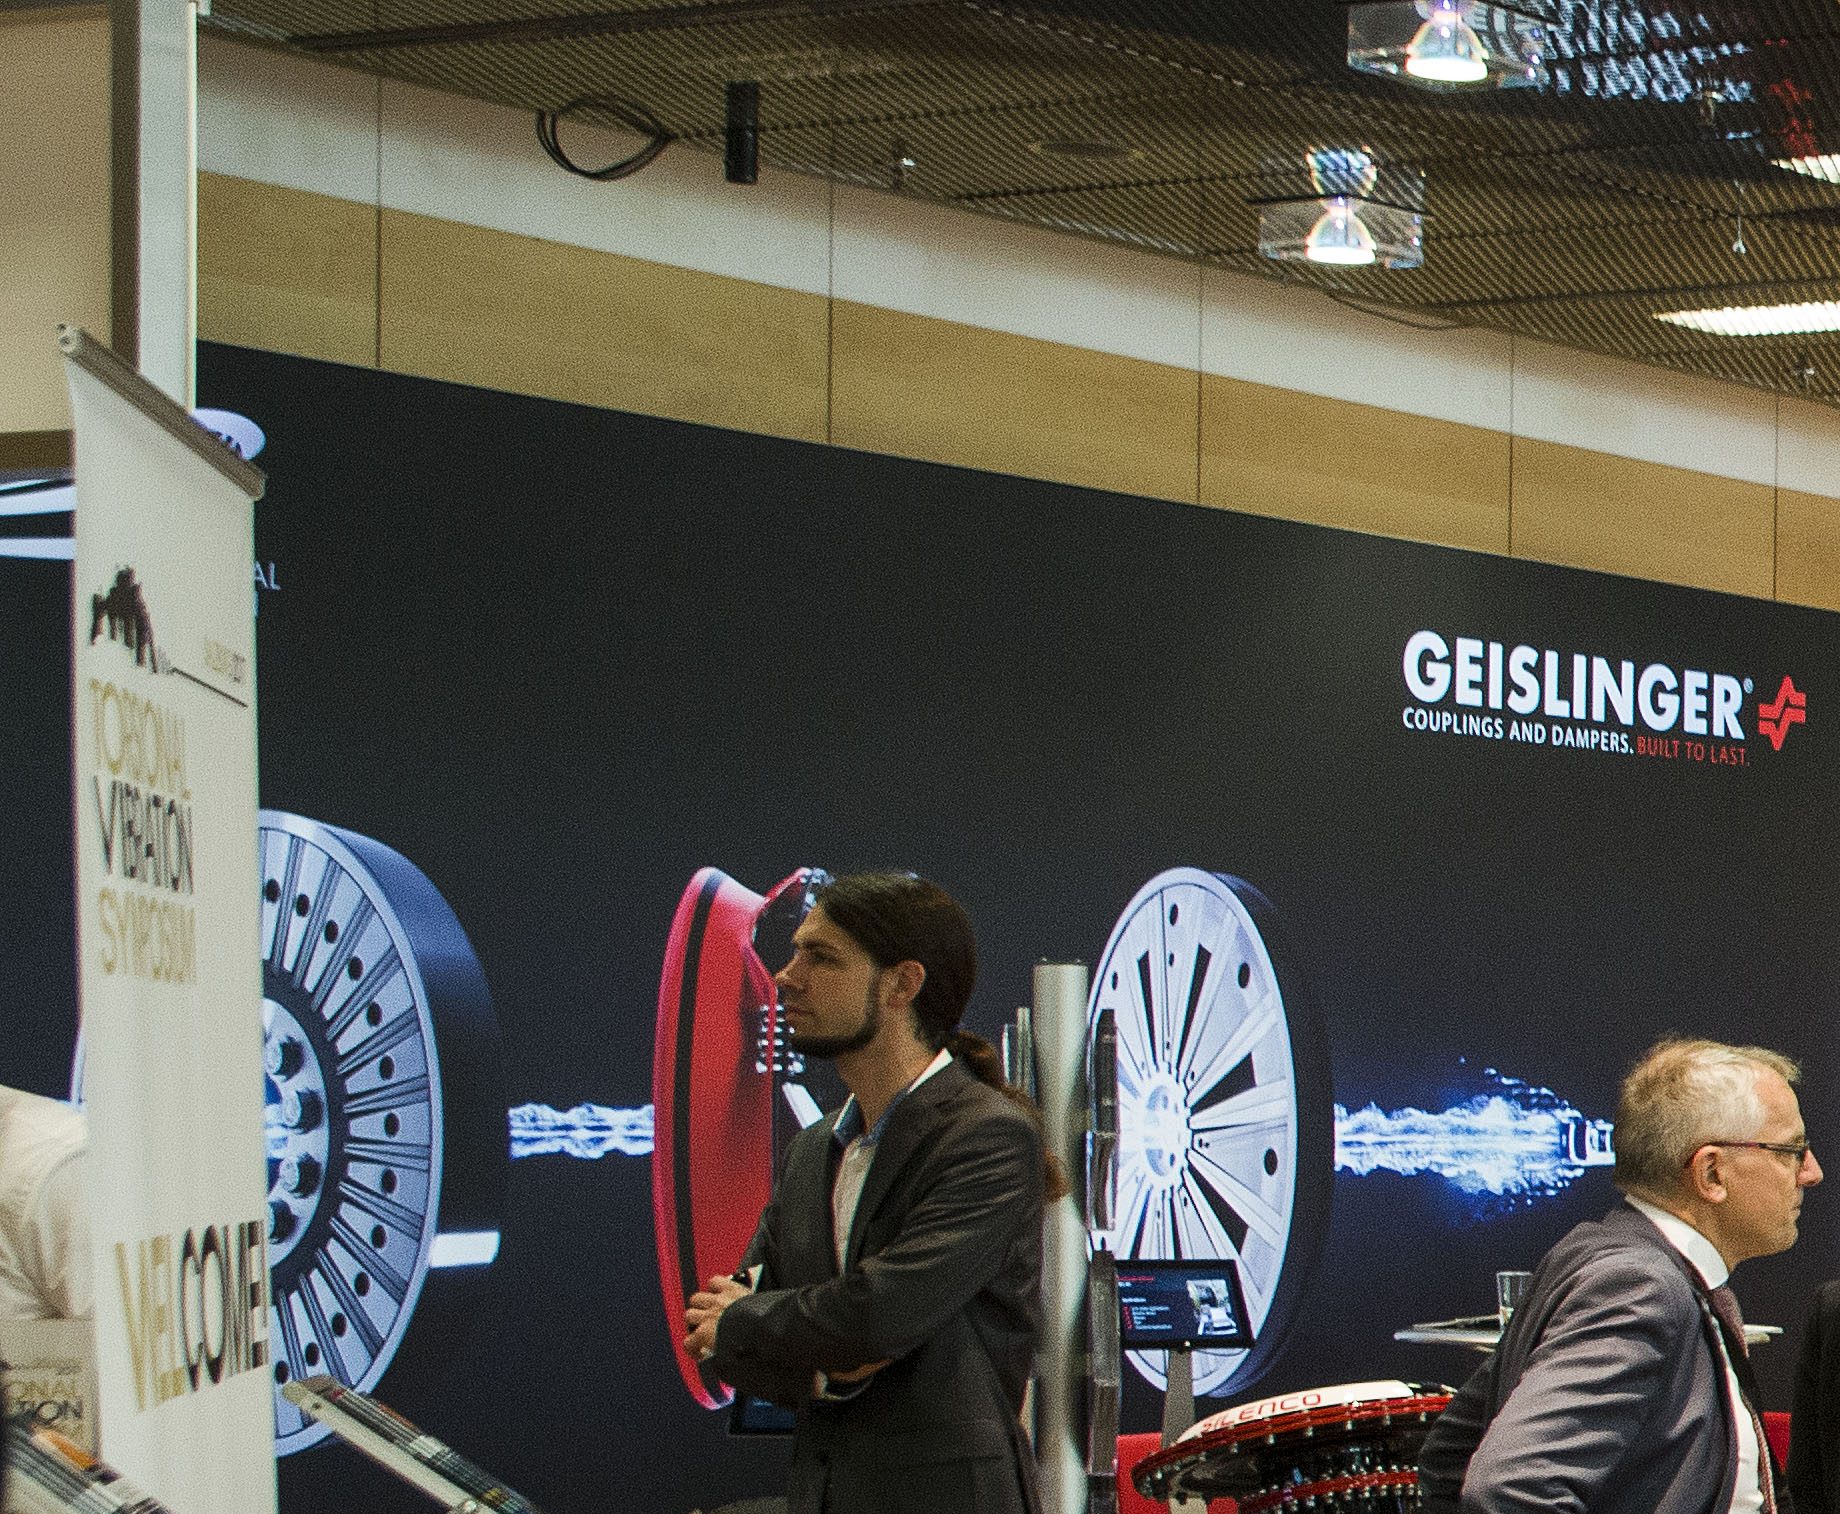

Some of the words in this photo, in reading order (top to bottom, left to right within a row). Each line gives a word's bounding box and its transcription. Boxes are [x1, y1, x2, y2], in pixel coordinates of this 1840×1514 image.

[1402, 706, 1504, 740] COUPLINGS
[1509, 720, 1547, 745] AND
[1551, 724, 1635, 755] DAMPERS.
[1636, 735, 1679, 759] BUILT
[1685, 742, 1705, 762] TO
[1710, 744, 1751, 767] LAST.
[1201, 1393, 1322, 1434] SILENCO
